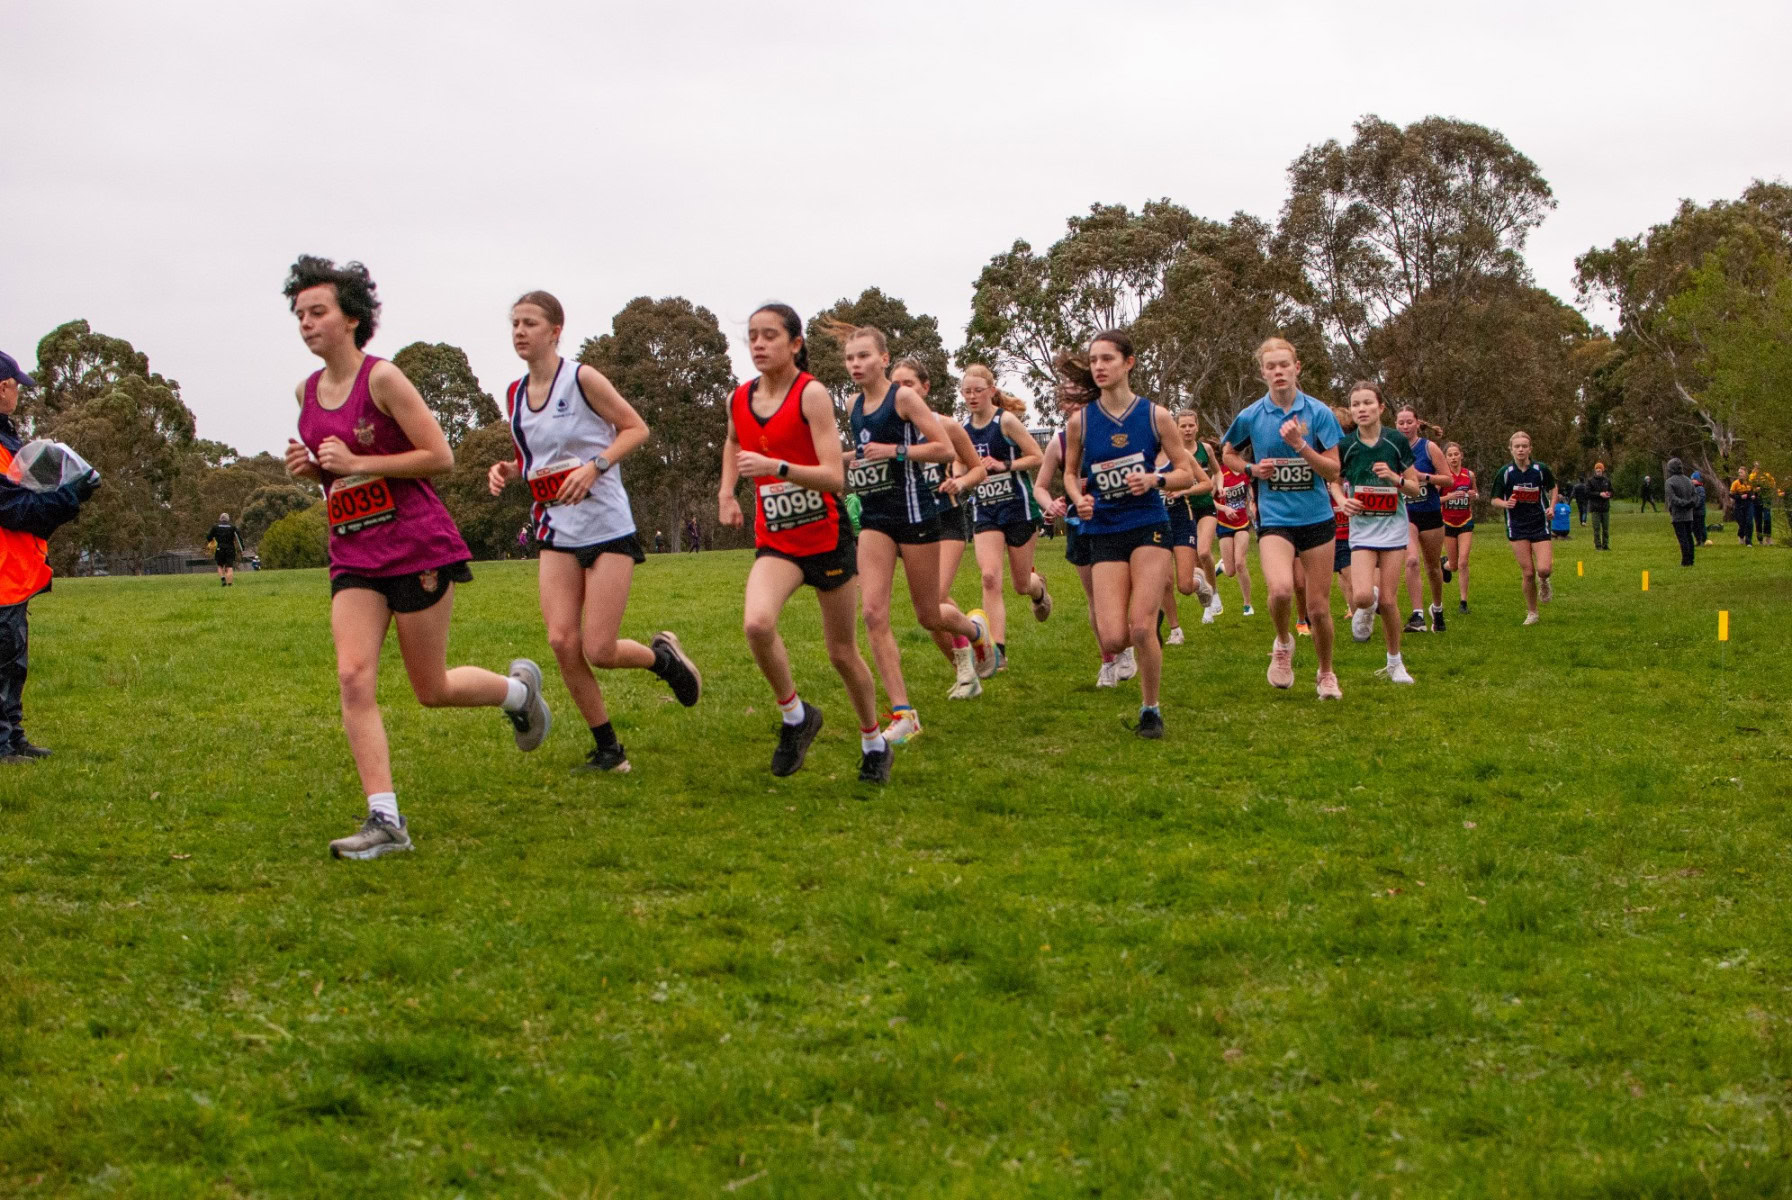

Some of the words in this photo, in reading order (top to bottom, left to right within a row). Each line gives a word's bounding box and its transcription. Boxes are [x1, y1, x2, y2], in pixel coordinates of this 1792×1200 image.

[847, 464, 889, 487] 9037
[1270, 466, 1313, 482] 9035
[331, 483, 387, 519] 8039
[977, 480, 1012, 499] 9024
[763, 490, 823, 519] 9098
